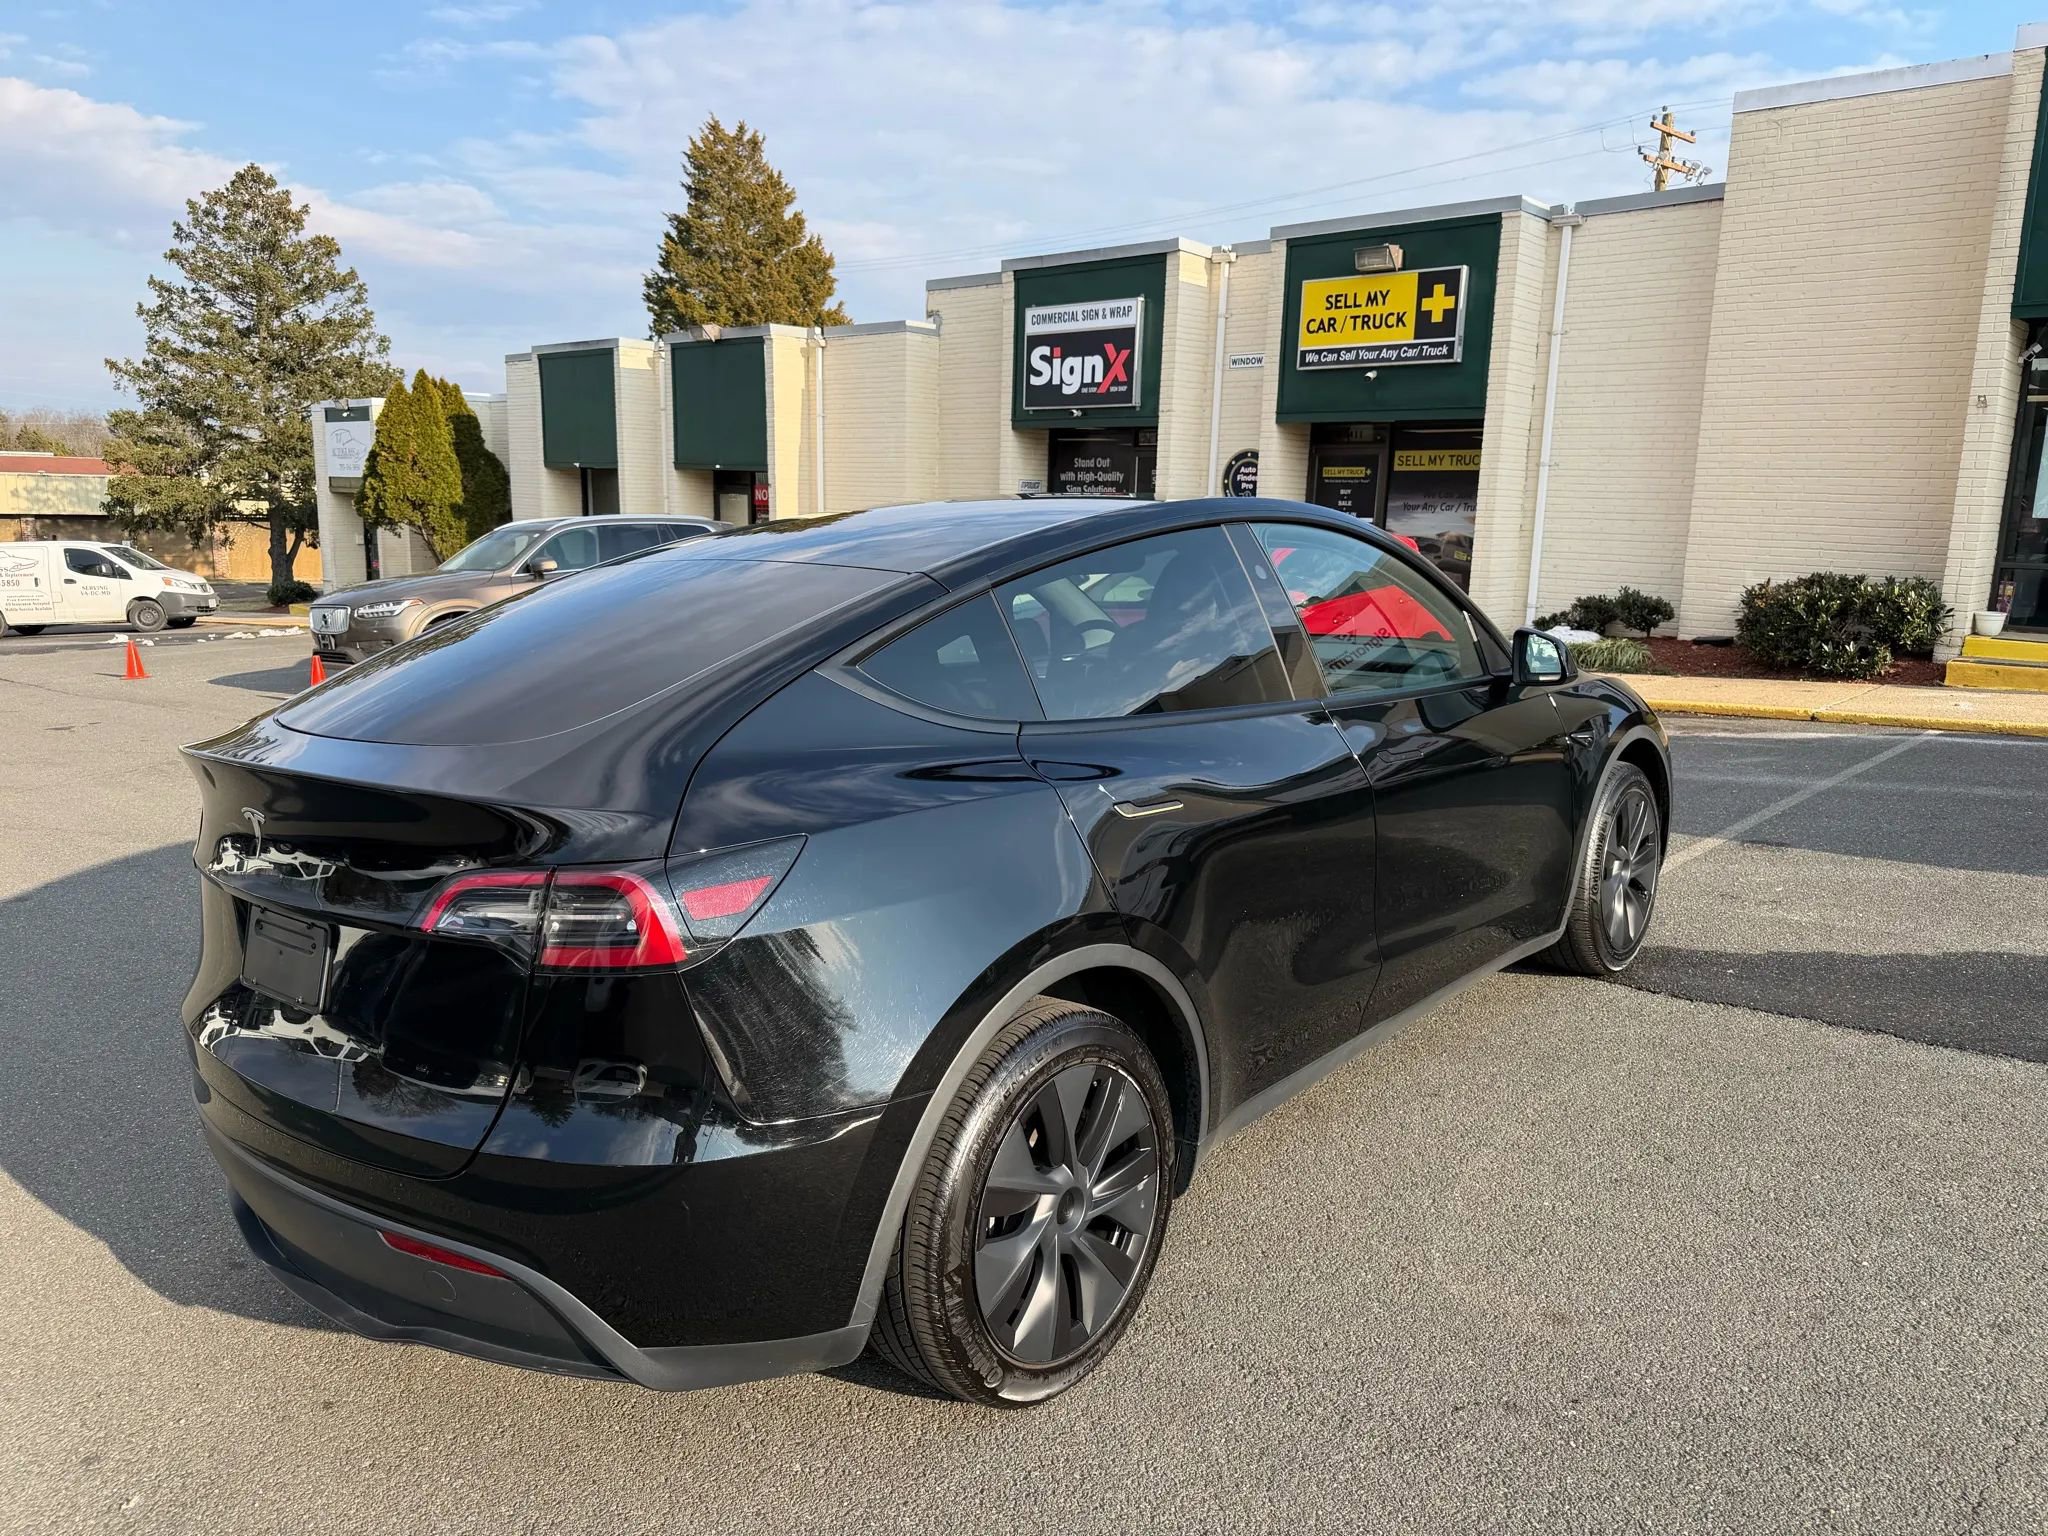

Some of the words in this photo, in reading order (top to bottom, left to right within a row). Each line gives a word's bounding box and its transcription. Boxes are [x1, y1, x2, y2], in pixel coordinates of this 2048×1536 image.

[1325, 291, 1362, 311] SELL
[1365, 289, 1391, 307] MY
[1031, 311, 1080, 326] COMMERCIAL
[1081, 308, 1099, 321] SIGN
[1101, 307, 1107, 320] &
[1109, 305, 1133, 319] WRAP
[1306, 316, 1337, 334] CAR
[1350, 311, 1407, 331] TRUCK
[1305, 352, 1319, 363] We
[1320, 351, 1338, 362] Can
[1339, 349, 1356, 360] Sell
[1358, 348, 1379, 360] Your
[1380, 348, 1398, 361] Any
[1422, 344, 1449, 355] Truck
[1231, 356, 1264, 366] WINDOW
[1074, 458, 1095, 468] Stand
[1096, 457, 1111, 468] Out
[1397, 454, 1425, 467] SELL
[1428, 454, 1445, 466] MY
[1239, 466, 1257, 474] Auto
[1060, 471, 1076, 481] with
[1077, 471, 1124, 483] High-Quality
[1236, 474, 1258, 482] Finde
[1066, 484, 1081, 493] Sign
[1083, 484, 1116, 493] Solutions
[1241, 482, 1254, 490] Pro
[755, 489, 768, 501] NO
[1403, 502, 1420, 512] Your
[1421, 502, 1439, 514] Any
[1440, 502, 1454, 512] Car
